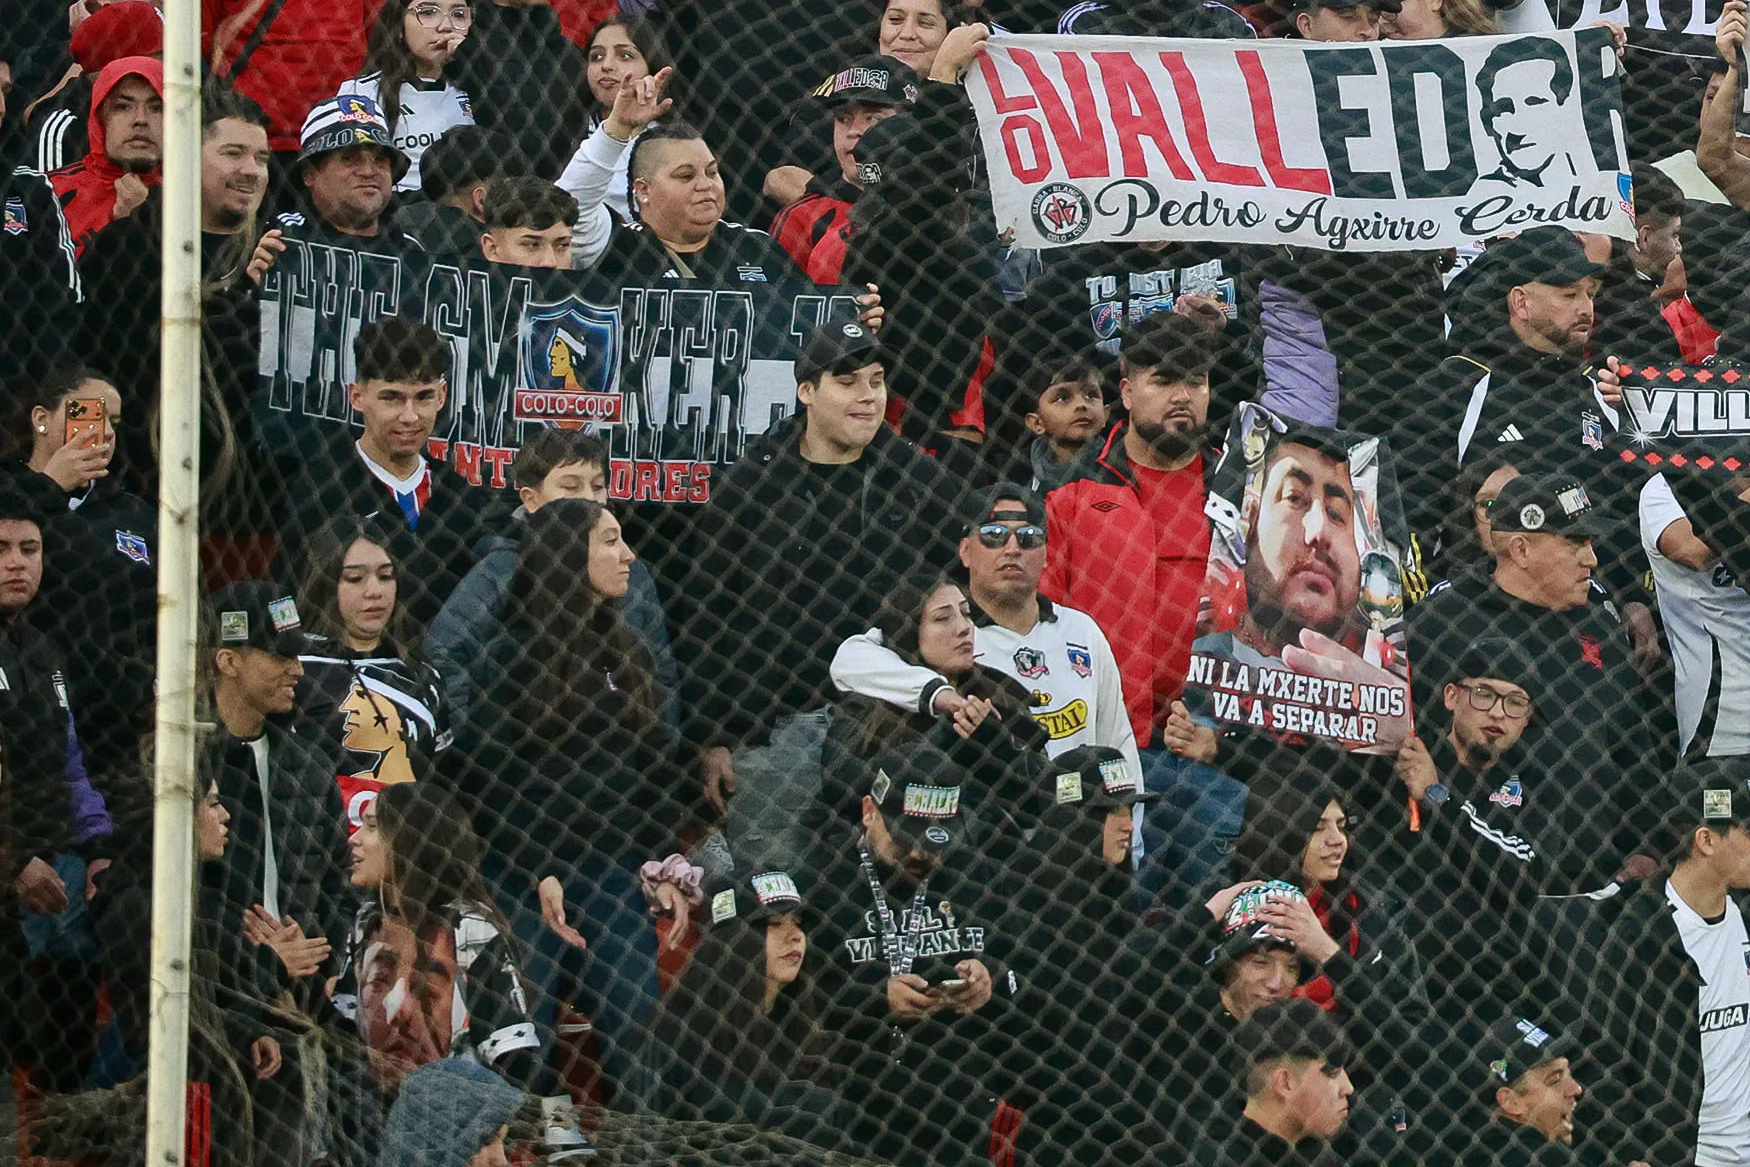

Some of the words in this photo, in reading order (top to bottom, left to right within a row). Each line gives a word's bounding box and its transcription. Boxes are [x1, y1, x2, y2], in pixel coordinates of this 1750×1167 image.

[1052, 184, 1085, 203] BLANCA
[1095, 178, 1266, 234] Pedro
[1277, 196, 1440, 248] Agxirre
[1455, 185, 1612, 236] Cerda
[520, 394, 616, 417] COLO-COLO
[1186, 656, 1214, 686] NI
[1220, 661, 1251, 692] LA
[1258, 668, 1352, 711] MXERTE
[1358, 684, 1405, 717] NOS
[1212, 691, 1241, 722] VA
[1248, 699, 1265, 726] A
[1271, 704, 1377, 744] SEPARAR
